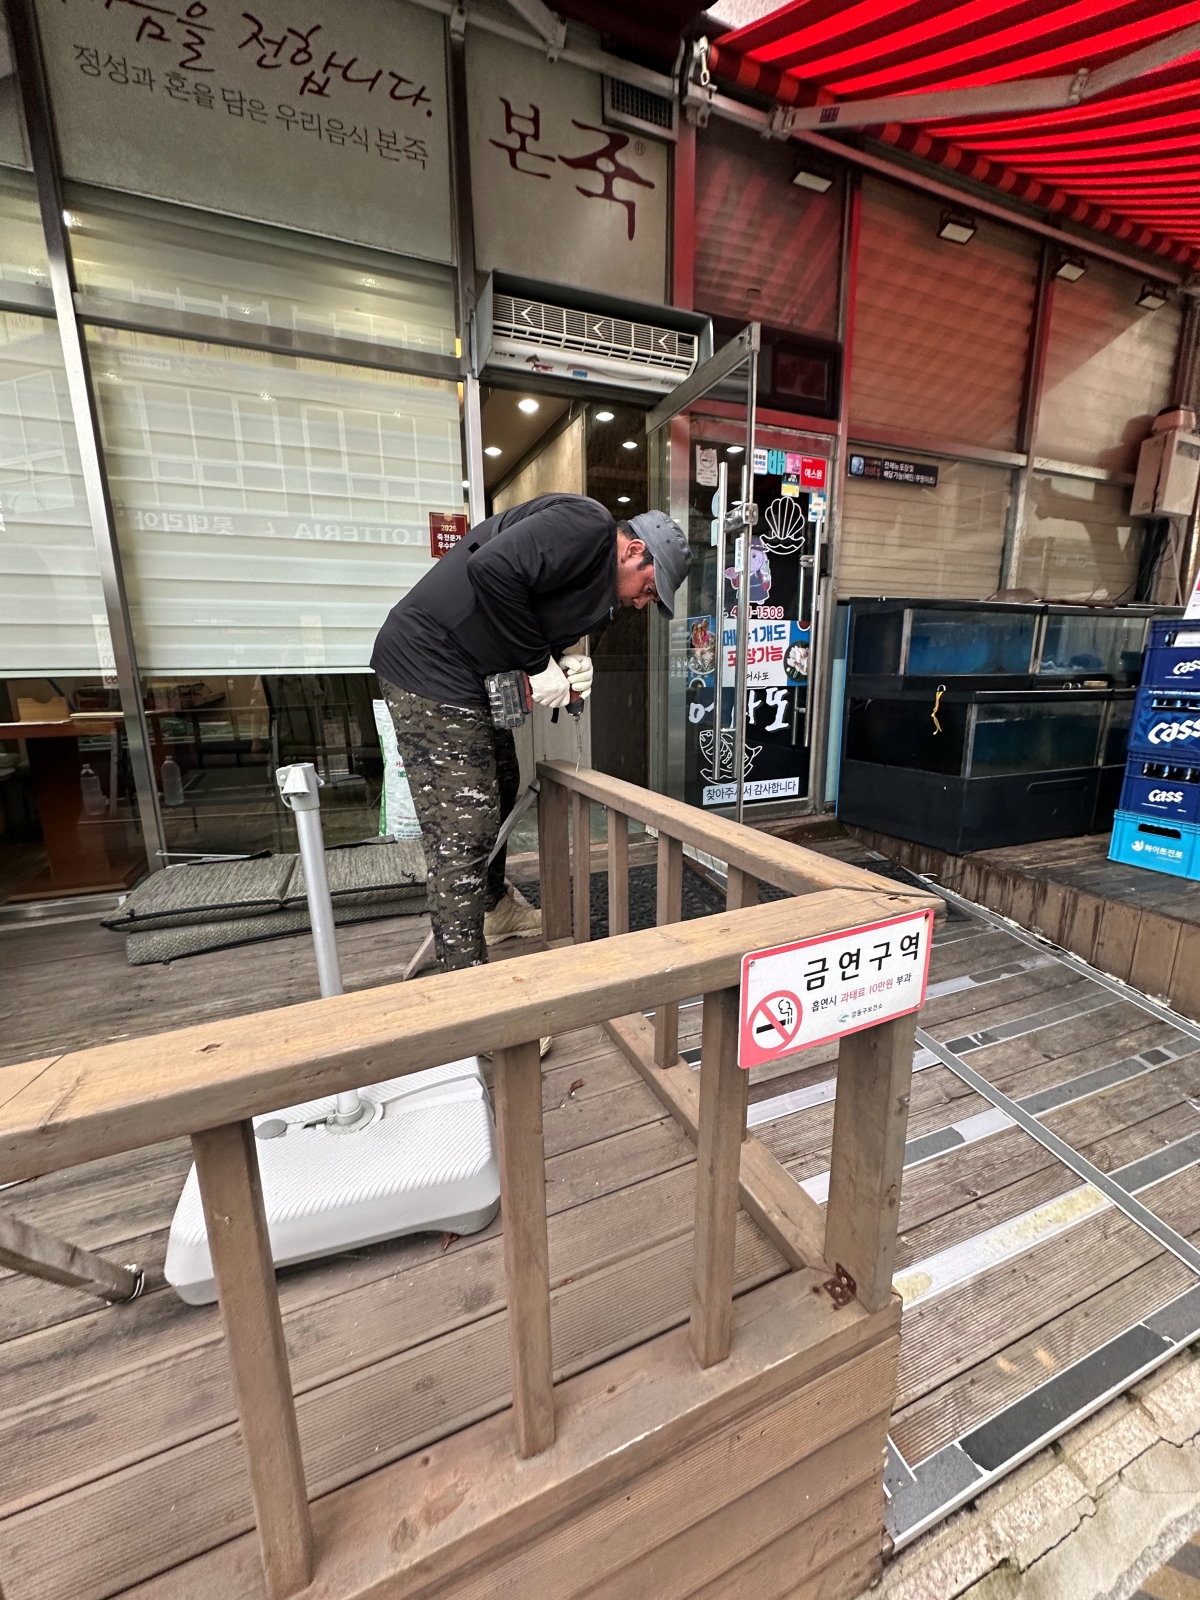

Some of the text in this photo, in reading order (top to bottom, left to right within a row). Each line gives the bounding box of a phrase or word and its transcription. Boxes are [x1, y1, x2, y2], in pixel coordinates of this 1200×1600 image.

[238, 13, 432, 118] 전합니다.
[73, 43, 430, 170] 정성과 혼을 담은 우리음식 본죽
[489, 97, 655, 241] 본죽
[805, 468, 822, 479] 에스원
[723, 624, 786, 646] 메1개도
[747, 671, 769, 681] 어사또
[754, 780, 796, 796] 감사합니다
[1148, 789, 1184, 802] Cass
[1145, 844, 1183, 858] 하이트진로
[812, 972, 912, 1012] 흡연시 과태료 10만원 부과
[851, 1003, 883, 1018] 강동구보건소
